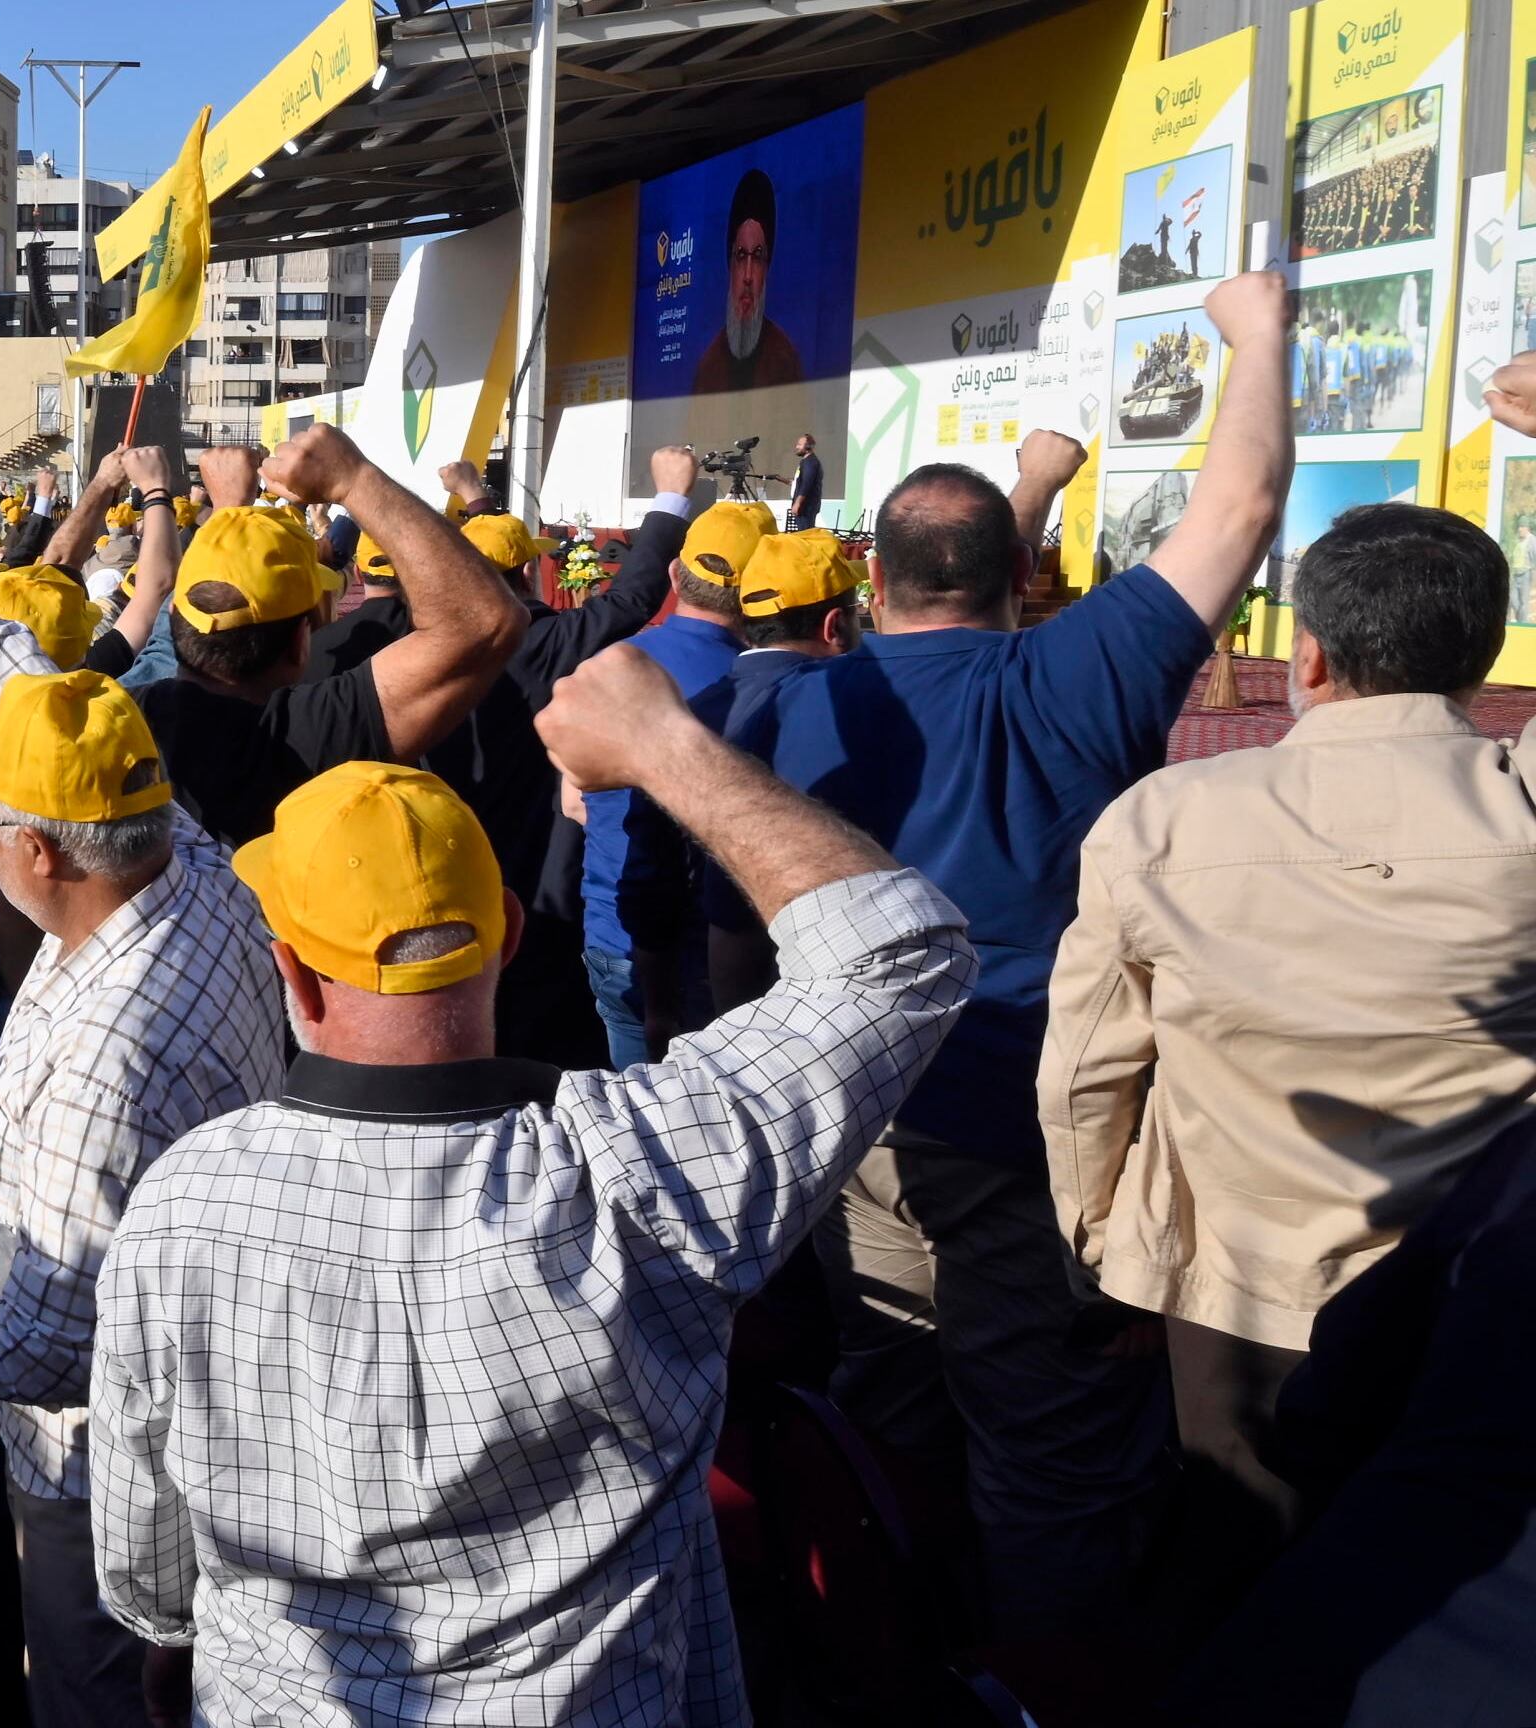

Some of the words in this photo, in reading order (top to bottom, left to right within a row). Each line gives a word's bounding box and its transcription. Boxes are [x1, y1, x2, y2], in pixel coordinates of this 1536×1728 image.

[1361, 7, 1402, 47] باقون
[1334, 58, 1361, 89] ونبني
[1363, 45, 1397, 80] نحمي
[295, 69, 311, 119] نحمي
[1172, 76, 1201, 110] باقون
[1152, 118, 1172, 144] ونبني
[1173, 109, 1198, 138] نحمي
[670, 226, 693, 265] باقون
[672, 266, 692, 298] نحمي
[1029, 300, 1070, 327] مهرجان
[976, 309, 1019, 355] باقون
[951, 364, 981, 398] ونبني
[982, 358, 1018, 395] نحمي
